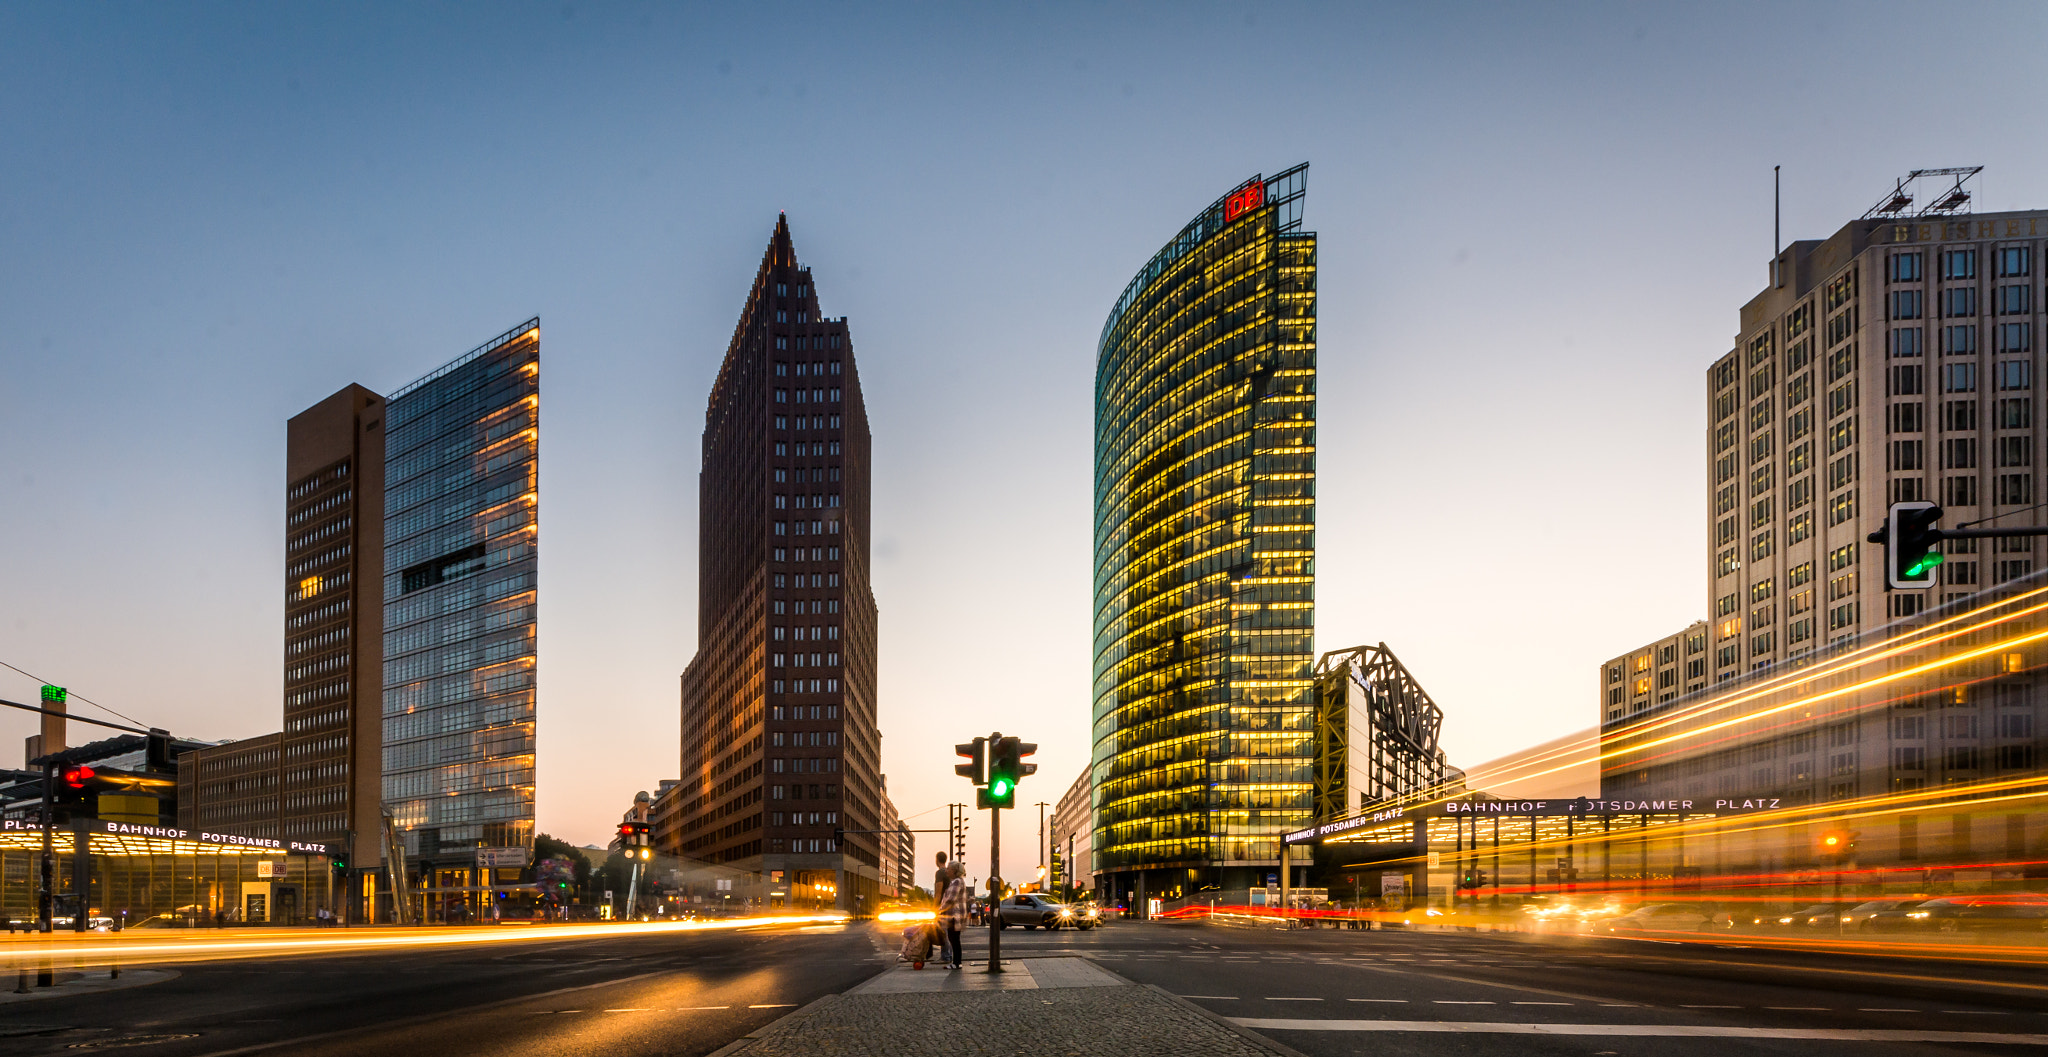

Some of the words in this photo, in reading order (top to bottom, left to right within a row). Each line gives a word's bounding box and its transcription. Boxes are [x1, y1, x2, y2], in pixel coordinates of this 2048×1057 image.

[1229, 188, 1258, 217] DB
[1894, 218, 2048, 242] BEISHEI
[1446, 801, 1547, 812] BAHNHOF
[1716, 799, 1780, 809] PLATZ
[4, 820, 58, 830] PLA
[107, 822, 188, 838] BAHNHOF
[202, 832, 280, 848] POTSDAMER
[291, 842, 326, 852] PLATZ
[1285, 828, 1315, 842] BAHNHOF
[1320, 816, 1366, 835] POTSDAMER
[1373, 807, 1403, 822] PLATZ
